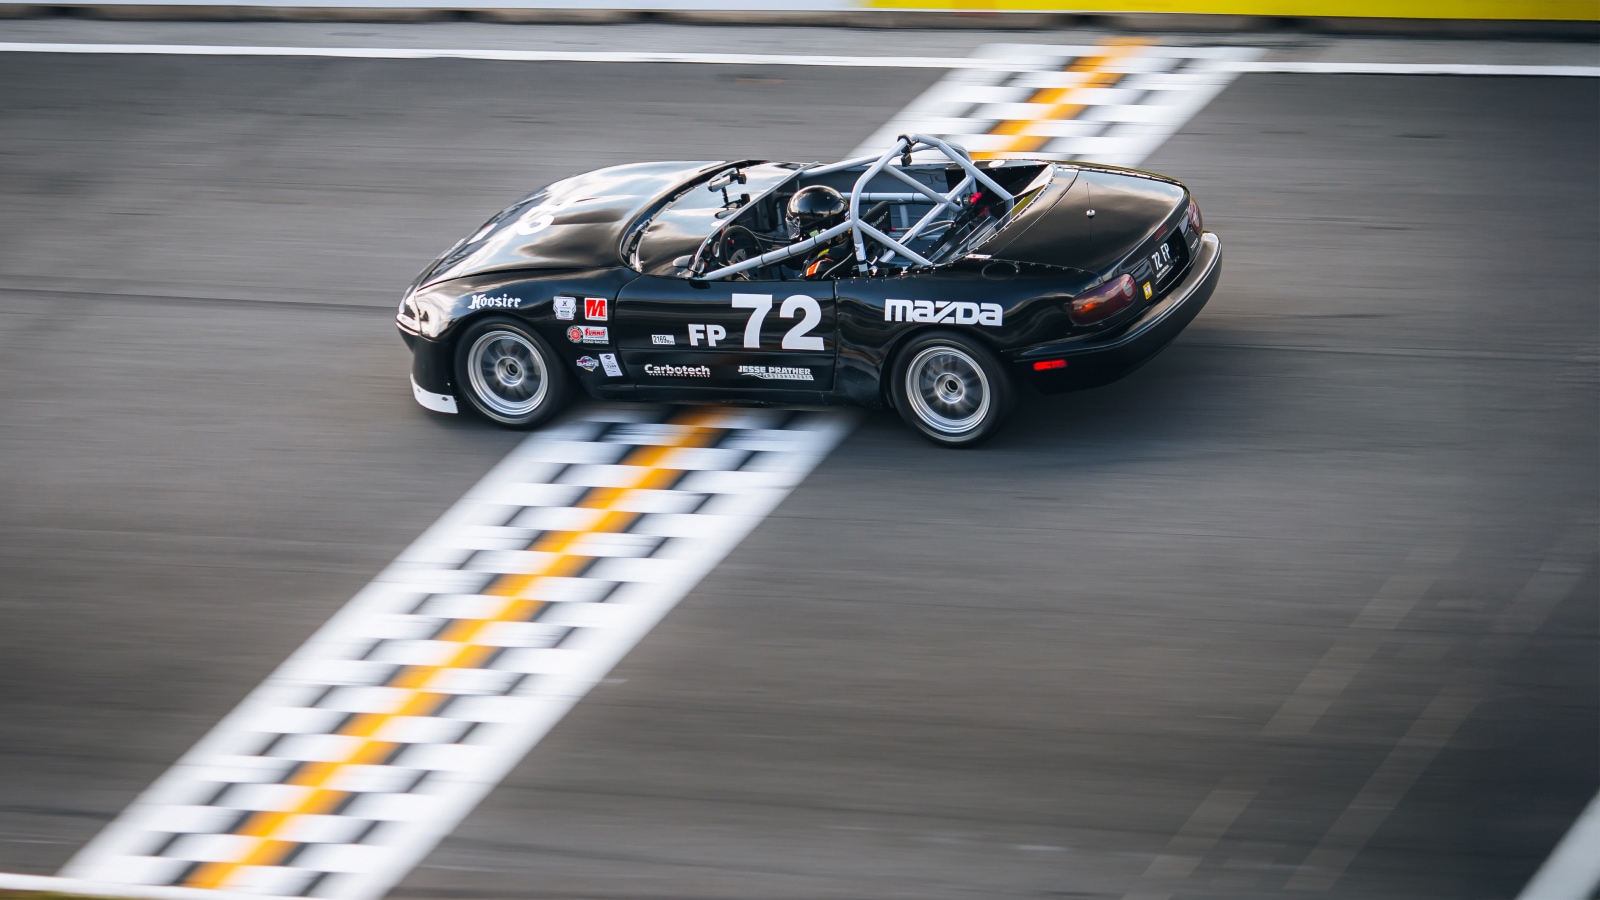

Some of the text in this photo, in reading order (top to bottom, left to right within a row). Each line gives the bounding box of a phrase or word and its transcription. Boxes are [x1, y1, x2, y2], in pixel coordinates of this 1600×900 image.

[1160, 242, 1170, 262] FP
[467, 293, 521, 309] Hoosier
[731, 293, 824, 350] 72
[884, 299, 1003, 326] mazda
[688, 323, 726, 347] FP
[644, 363, 710, 375] Carbotech
[738, 365, 811, 375] JESSE PRATHER
